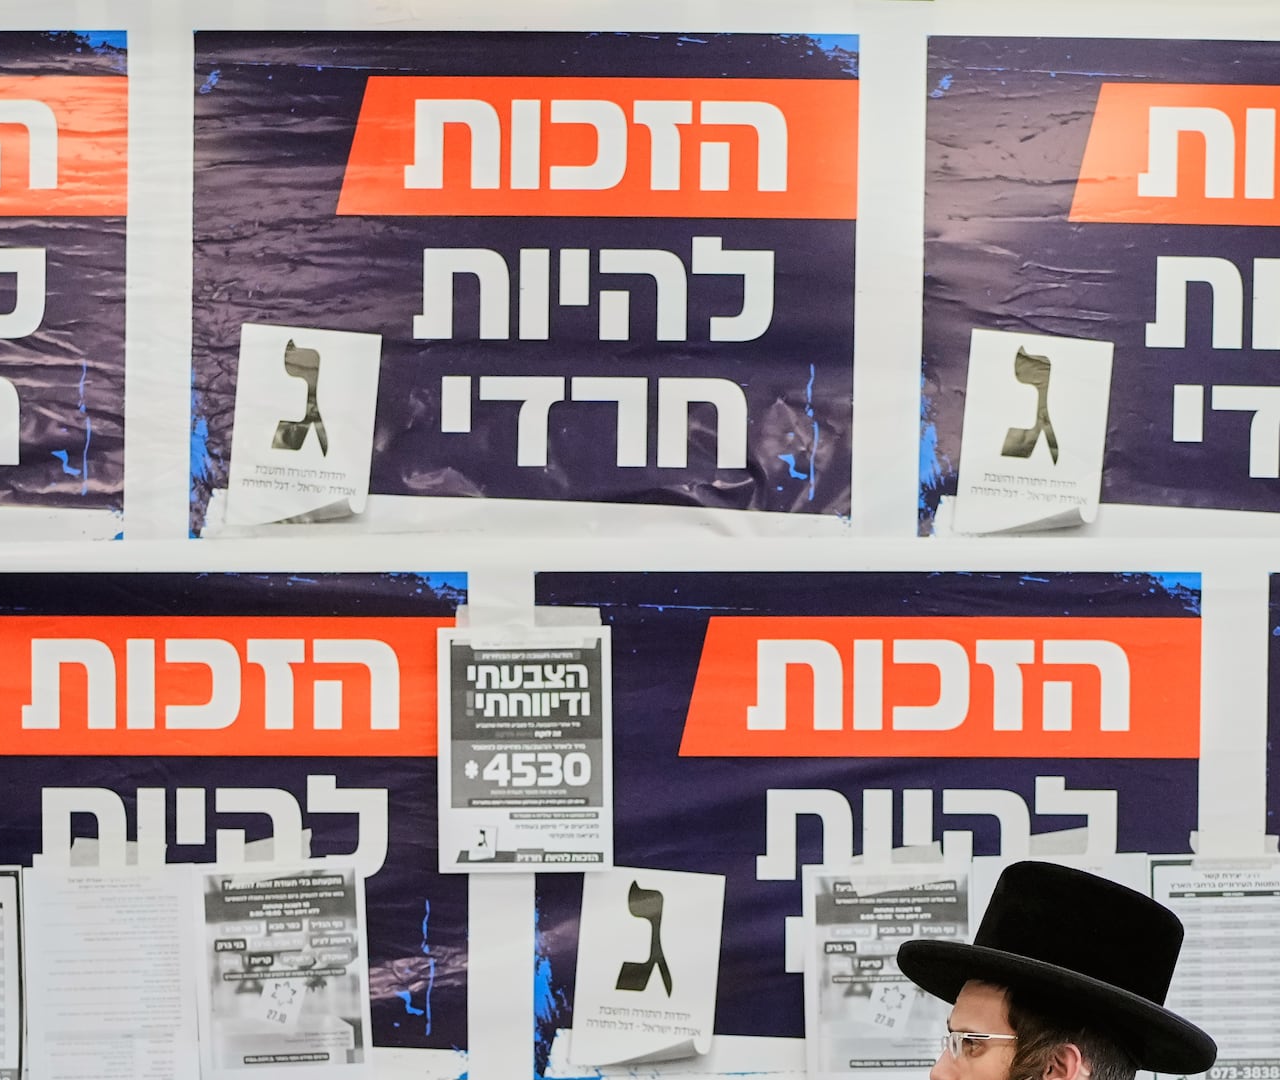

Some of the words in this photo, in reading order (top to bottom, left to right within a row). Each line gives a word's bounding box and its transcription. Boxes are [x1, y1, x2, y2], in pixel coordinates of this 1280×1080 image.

[404, 99, 787, 191] הזכות
[413, 237, 774, 341] להיות
[273, 339, 328, 457] ג
[442, 376, 747, 468] חרדי
[1001, 346, 1058, 465] ג
[22, 639, 400, 729] הזכות
[467, 664, 588, 689] הצבעתי
[747, 640, 1130, 731] הזכות
[615, 880, 672, 998] ג
